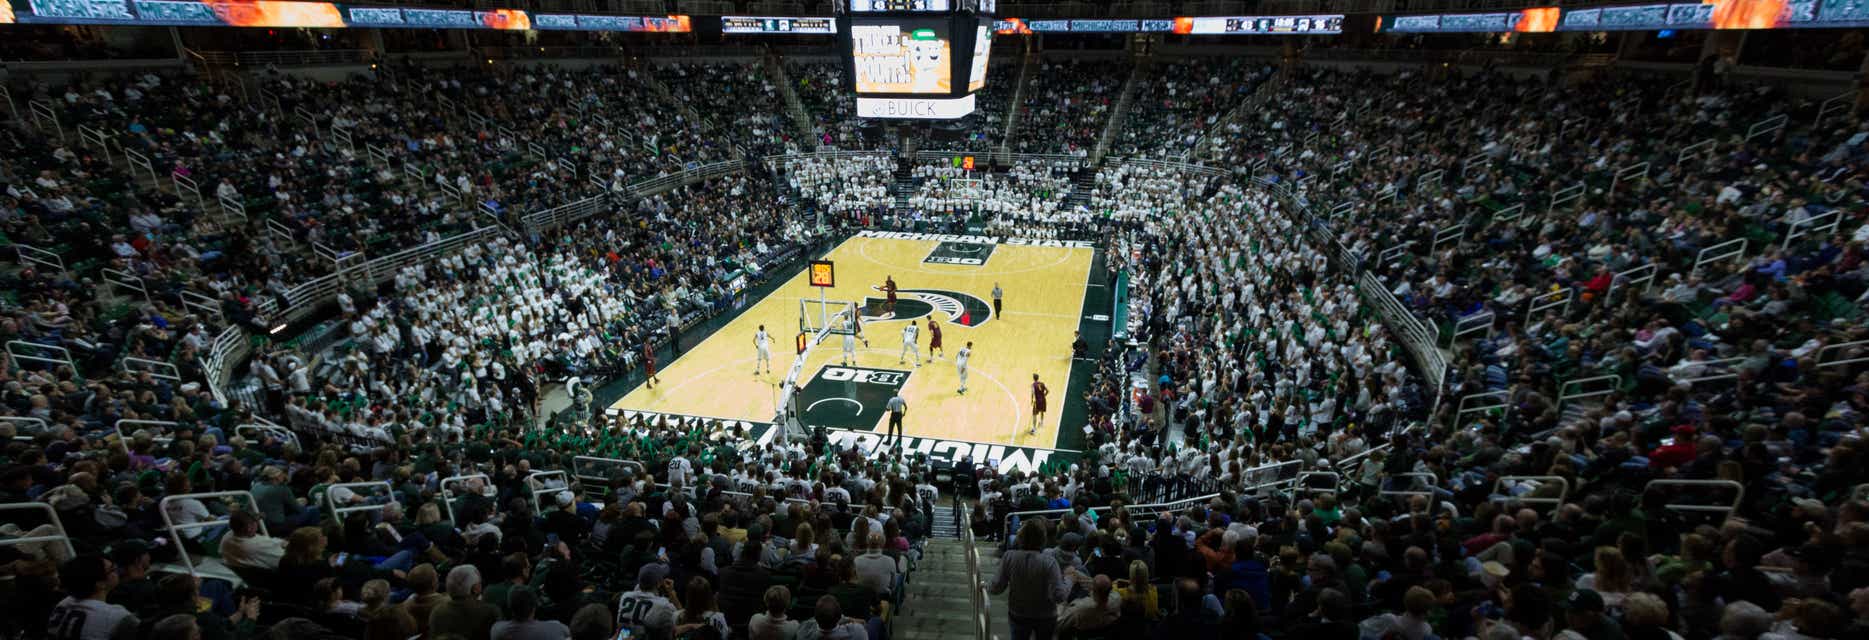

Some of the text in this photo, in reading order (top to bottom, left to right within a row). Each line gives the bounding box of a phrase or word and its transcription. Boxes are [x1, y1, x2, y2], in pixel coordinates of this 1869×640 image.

[888, 100, 936, 116] BUICK
[855, 230, 1095, 249] MICHIGAN STATE
